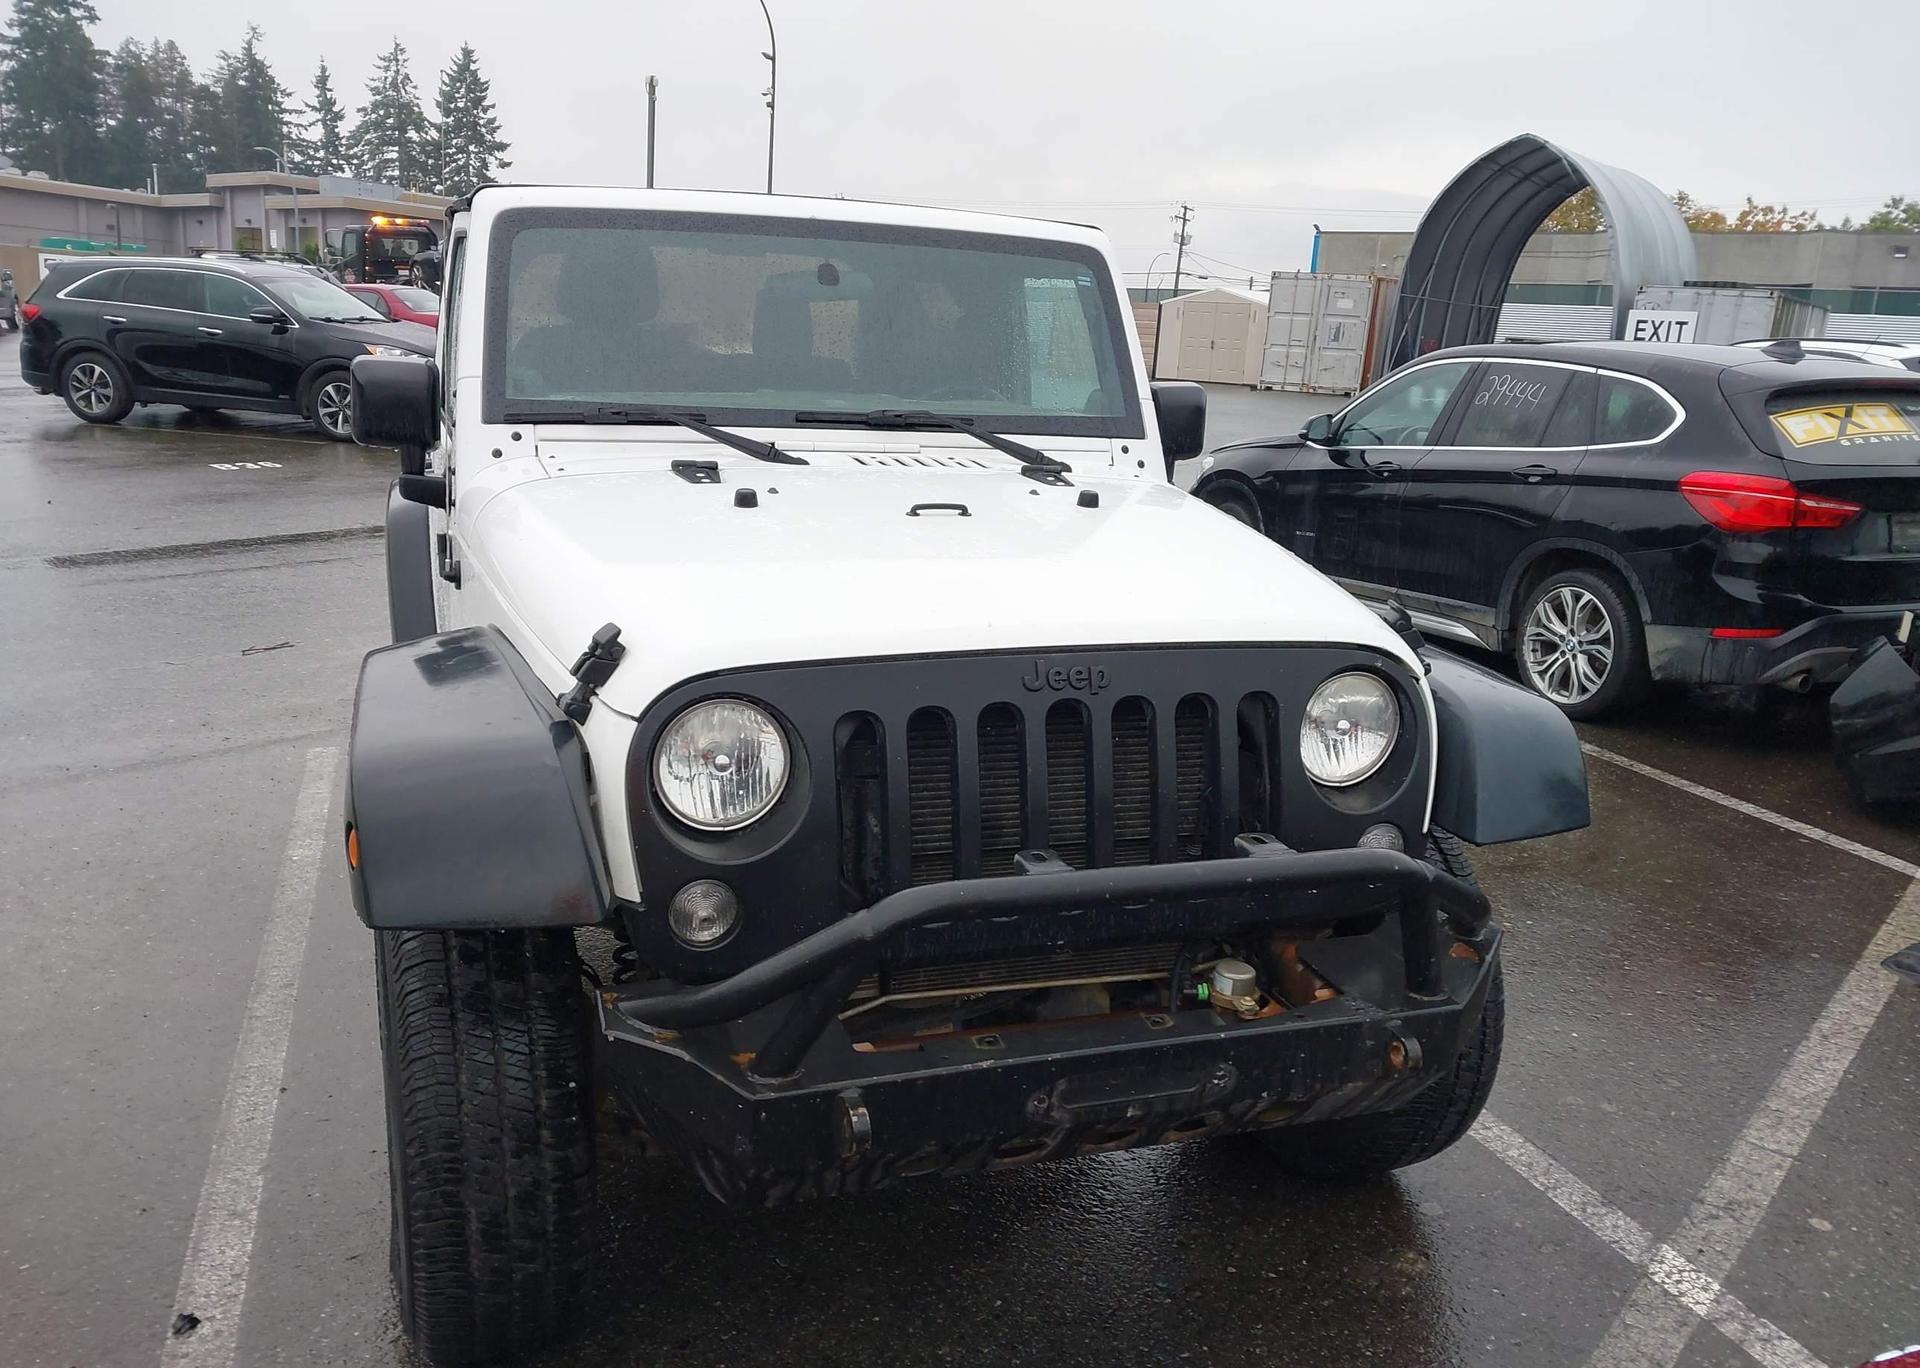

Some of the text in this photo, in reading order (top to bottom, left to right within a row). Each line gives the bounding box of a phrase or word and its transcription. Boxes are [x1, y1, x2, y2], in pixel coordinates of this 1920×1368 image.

[1634, 319, 1689, 343] EXIT
[1475, 374, 1547, 412] 29444
[1778, 404, 1900, 440] FIXIT
[1021, 659, 1111, 695] Jeep
